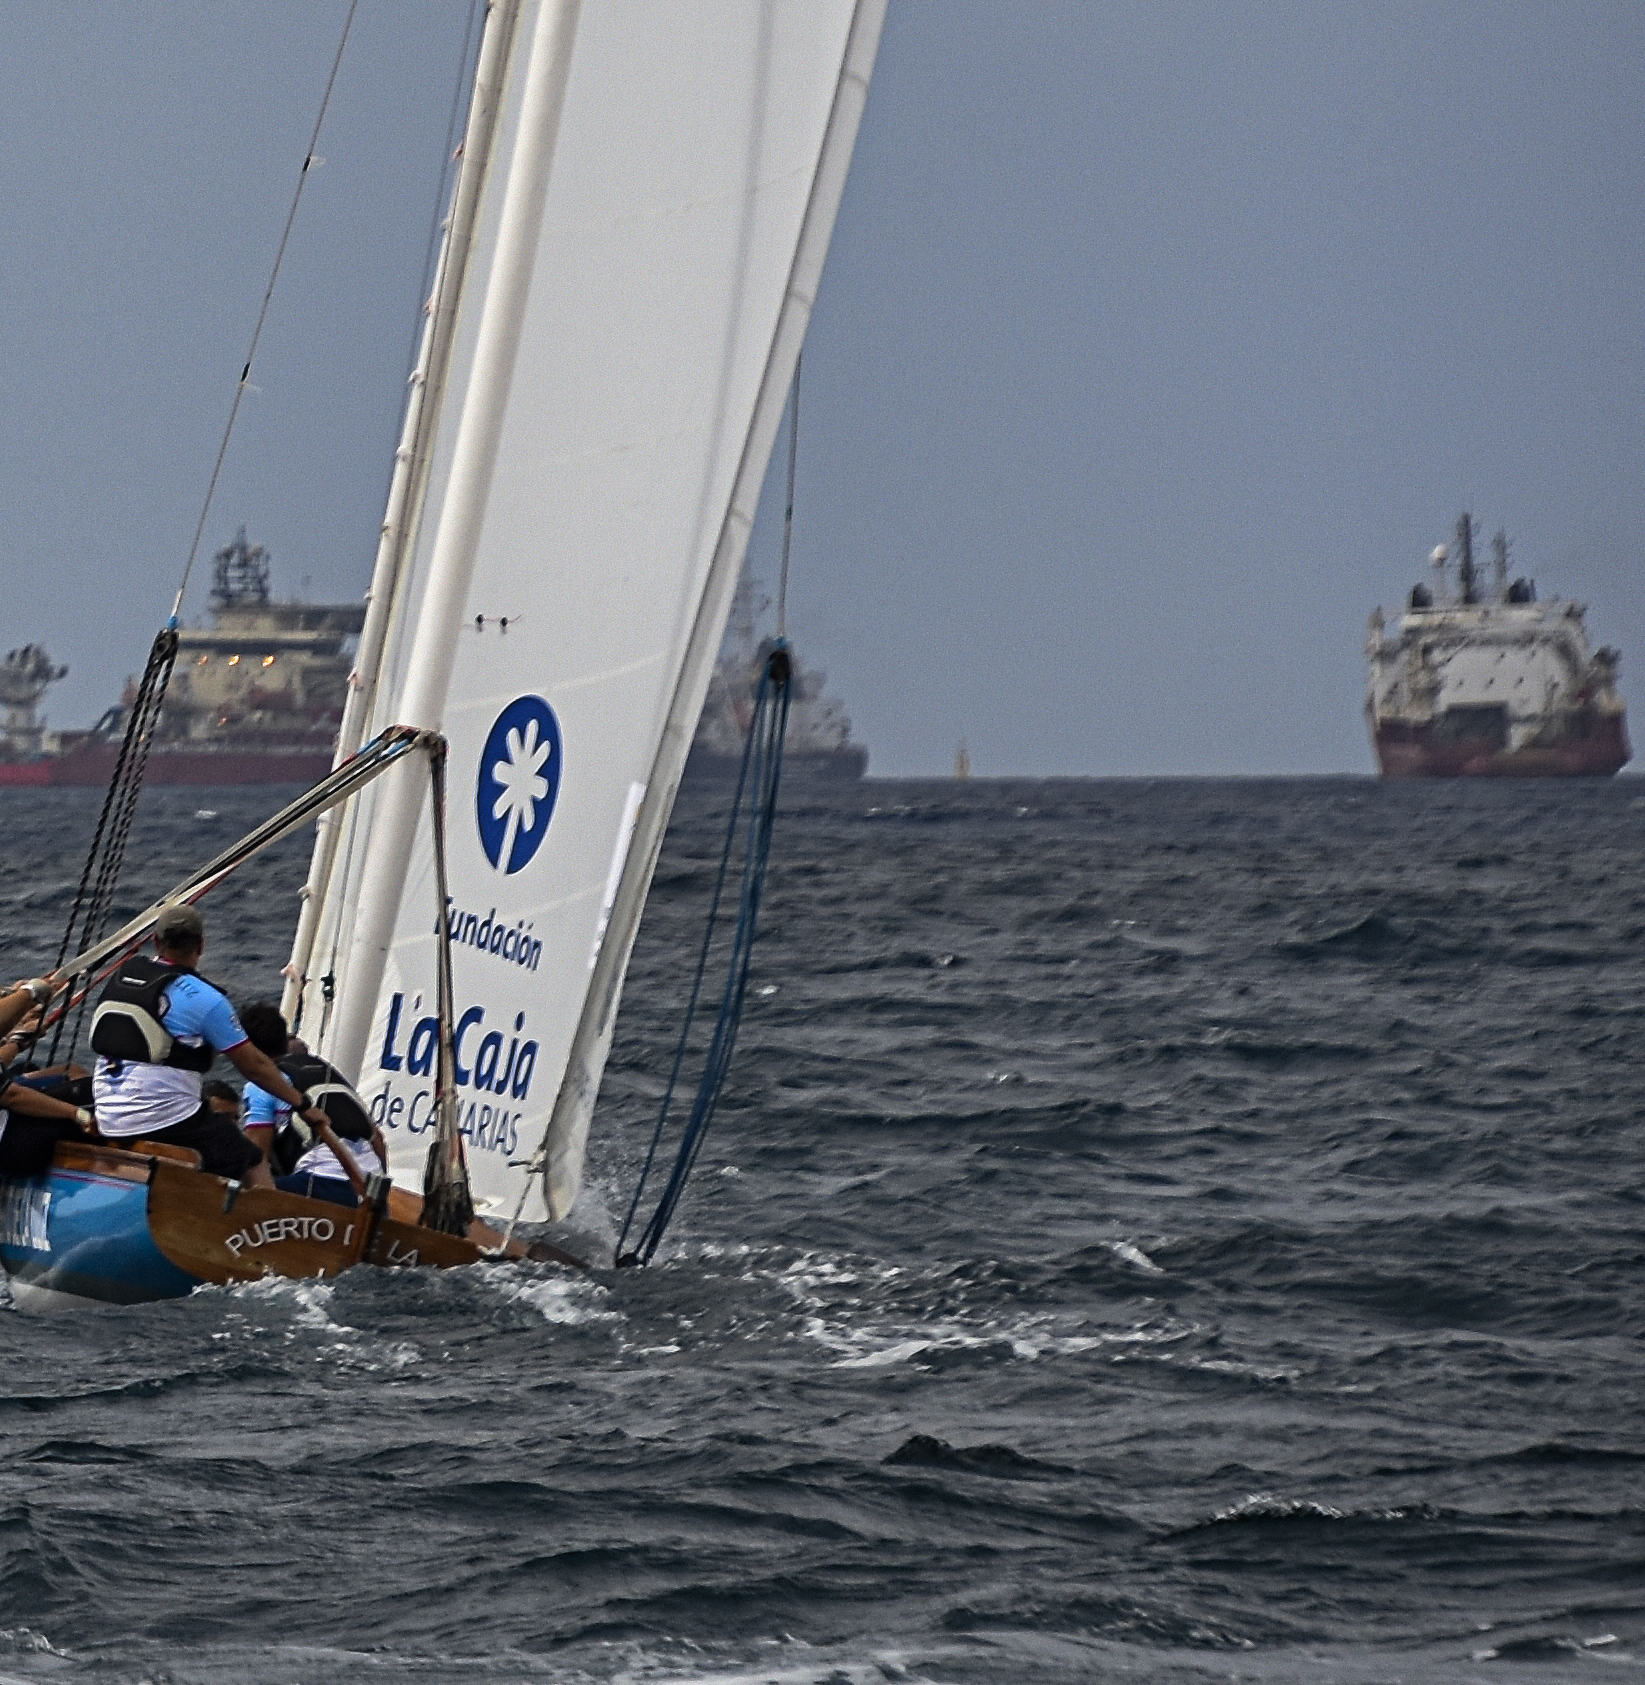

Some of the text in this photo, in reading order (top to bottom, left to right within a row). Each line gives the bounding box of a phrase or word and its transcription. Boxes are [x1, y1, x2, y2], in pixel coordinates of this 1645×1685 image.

[451, 1005, 539, 1101] Caja
[369, 1080, 405, 1129] de
[224, 1217, 336, 1259] PUERTO
[387, 1238, 419, 1268] LA
